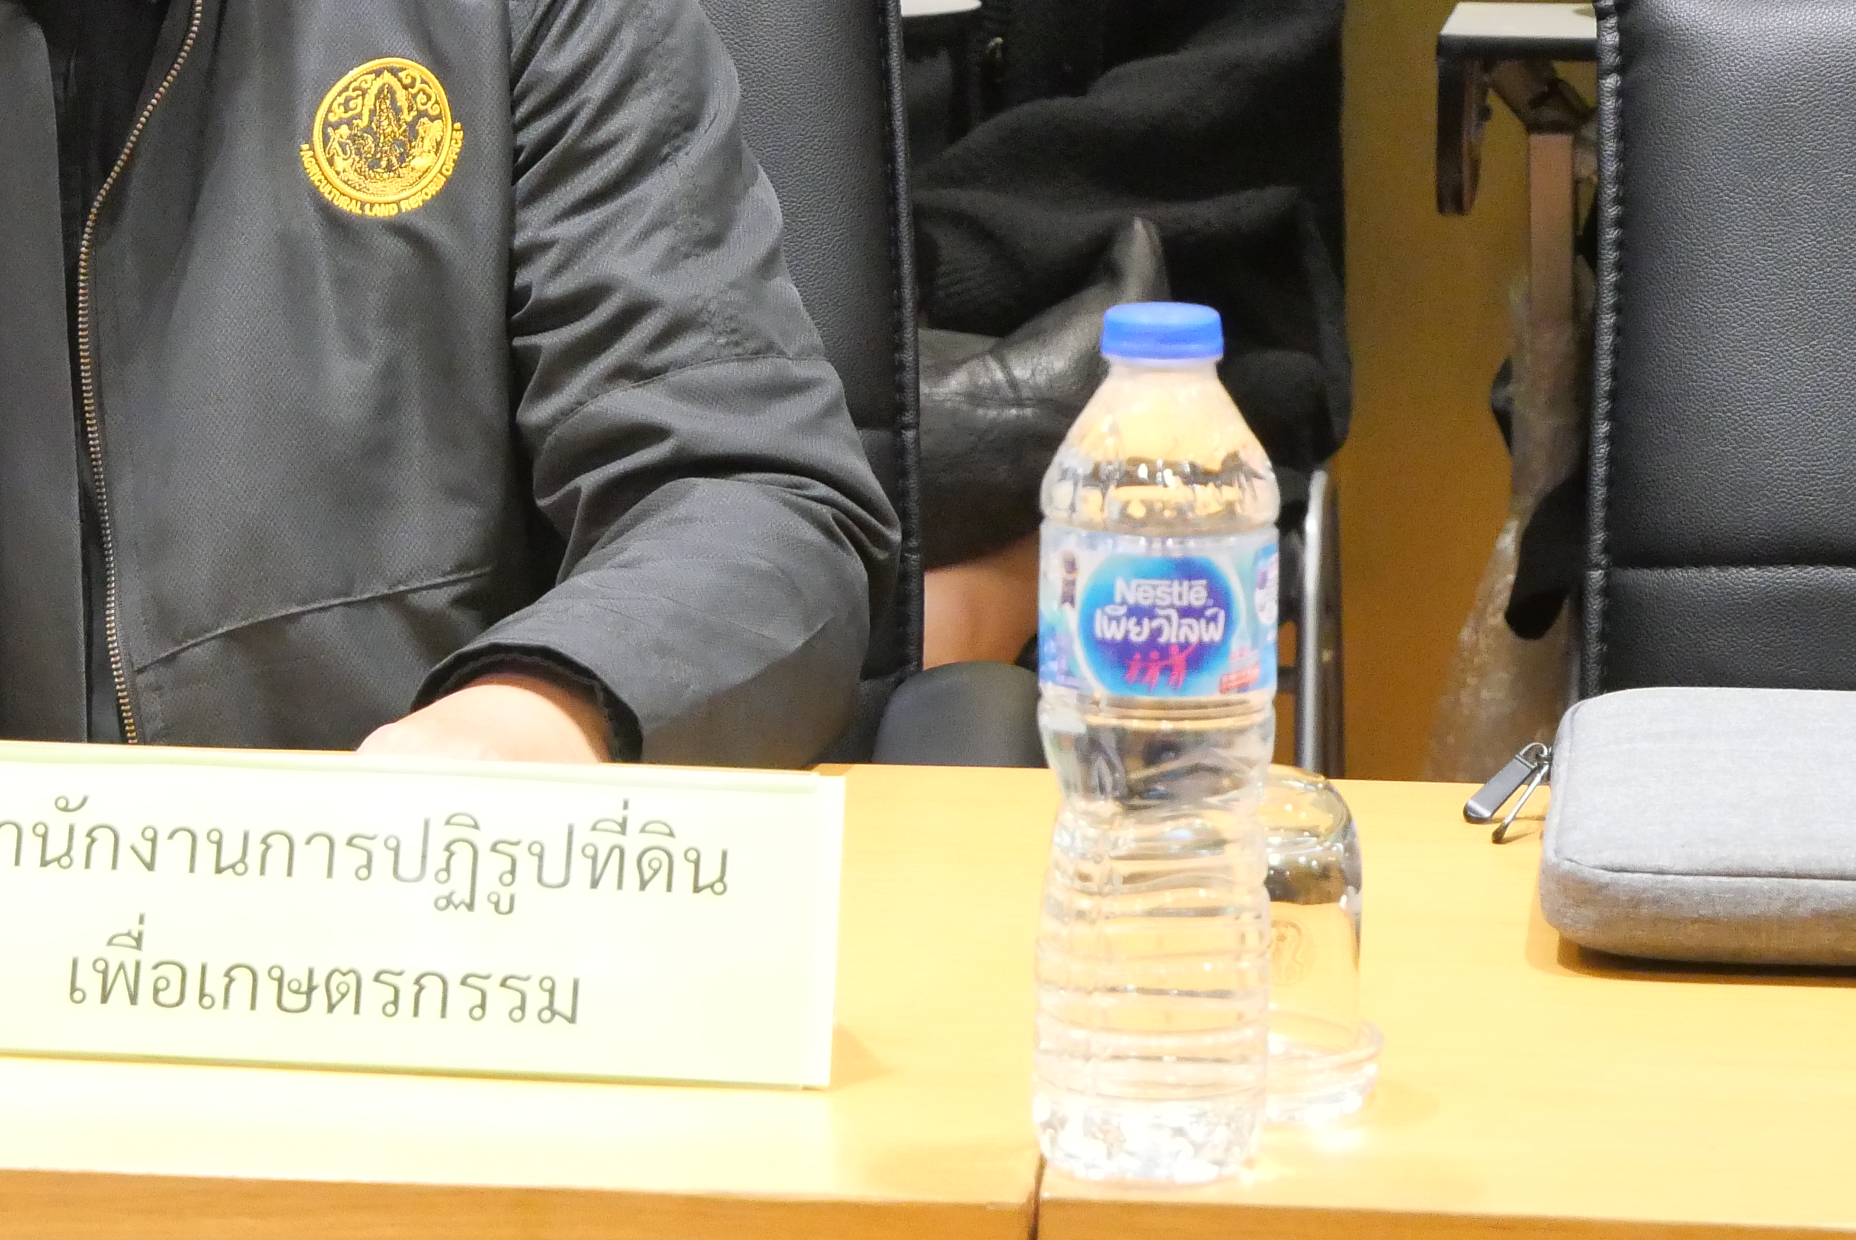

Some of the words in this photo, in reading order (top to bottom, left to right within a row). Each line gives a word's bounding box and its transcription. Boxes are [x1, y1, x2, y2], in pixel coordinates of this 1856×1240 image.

[299, 150, 362, 215] AGRICULTURAL
[364, 202, 399, 217] LAND
[399, 172, 447, 213] REFORM
[441, 130, 464, 176] OFFICE
[67, 914, 580, 1026] เพื่อเกษตรกรรม
